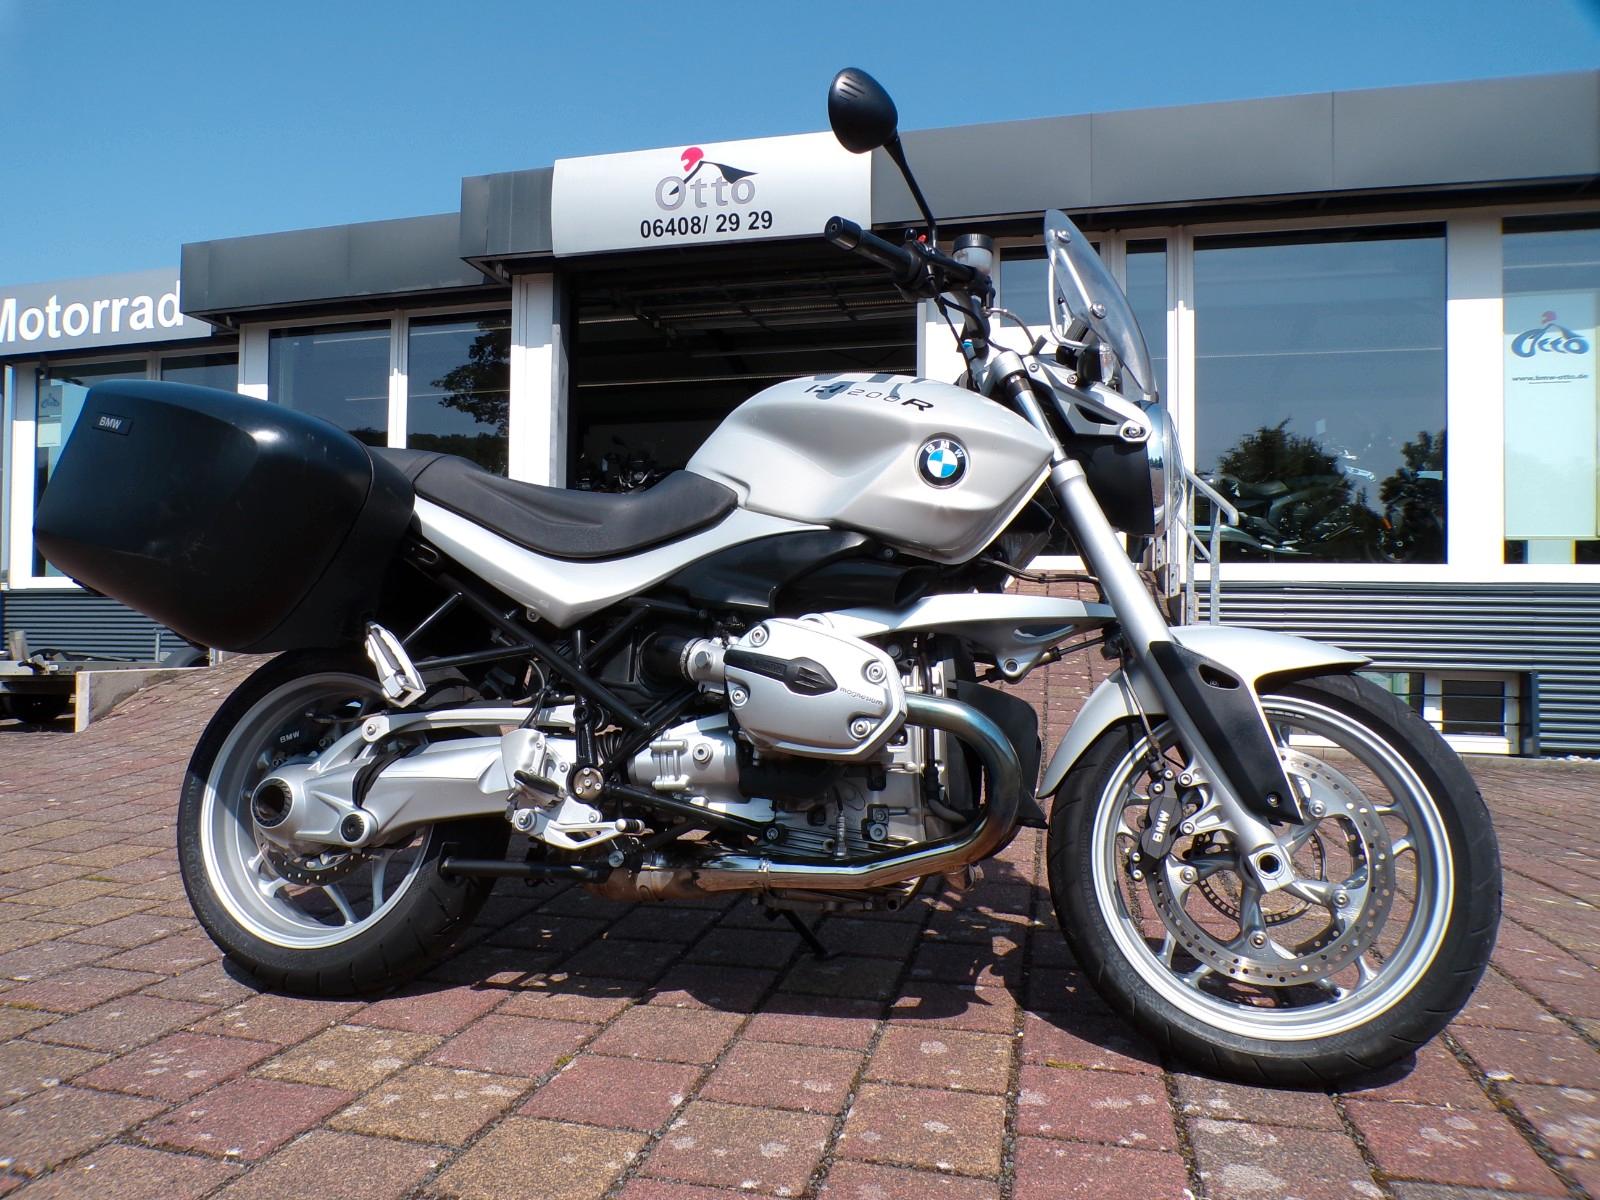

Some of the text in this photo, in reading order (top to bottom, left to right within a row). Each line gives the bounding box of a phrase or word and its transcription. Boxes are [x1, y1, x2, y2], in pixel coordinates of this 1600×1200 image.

[655, 176, 755, 211] Otto
[640, 210, 773, 239] 06408/ 29 29
[98, 416, 122, 430] BMW
[925, 440, 964, 458] BMW
[839, 687, 883, 705] magnesium
[280, 730, 300, 743] BMW
[1152, 810, 1170, 843] BMW
